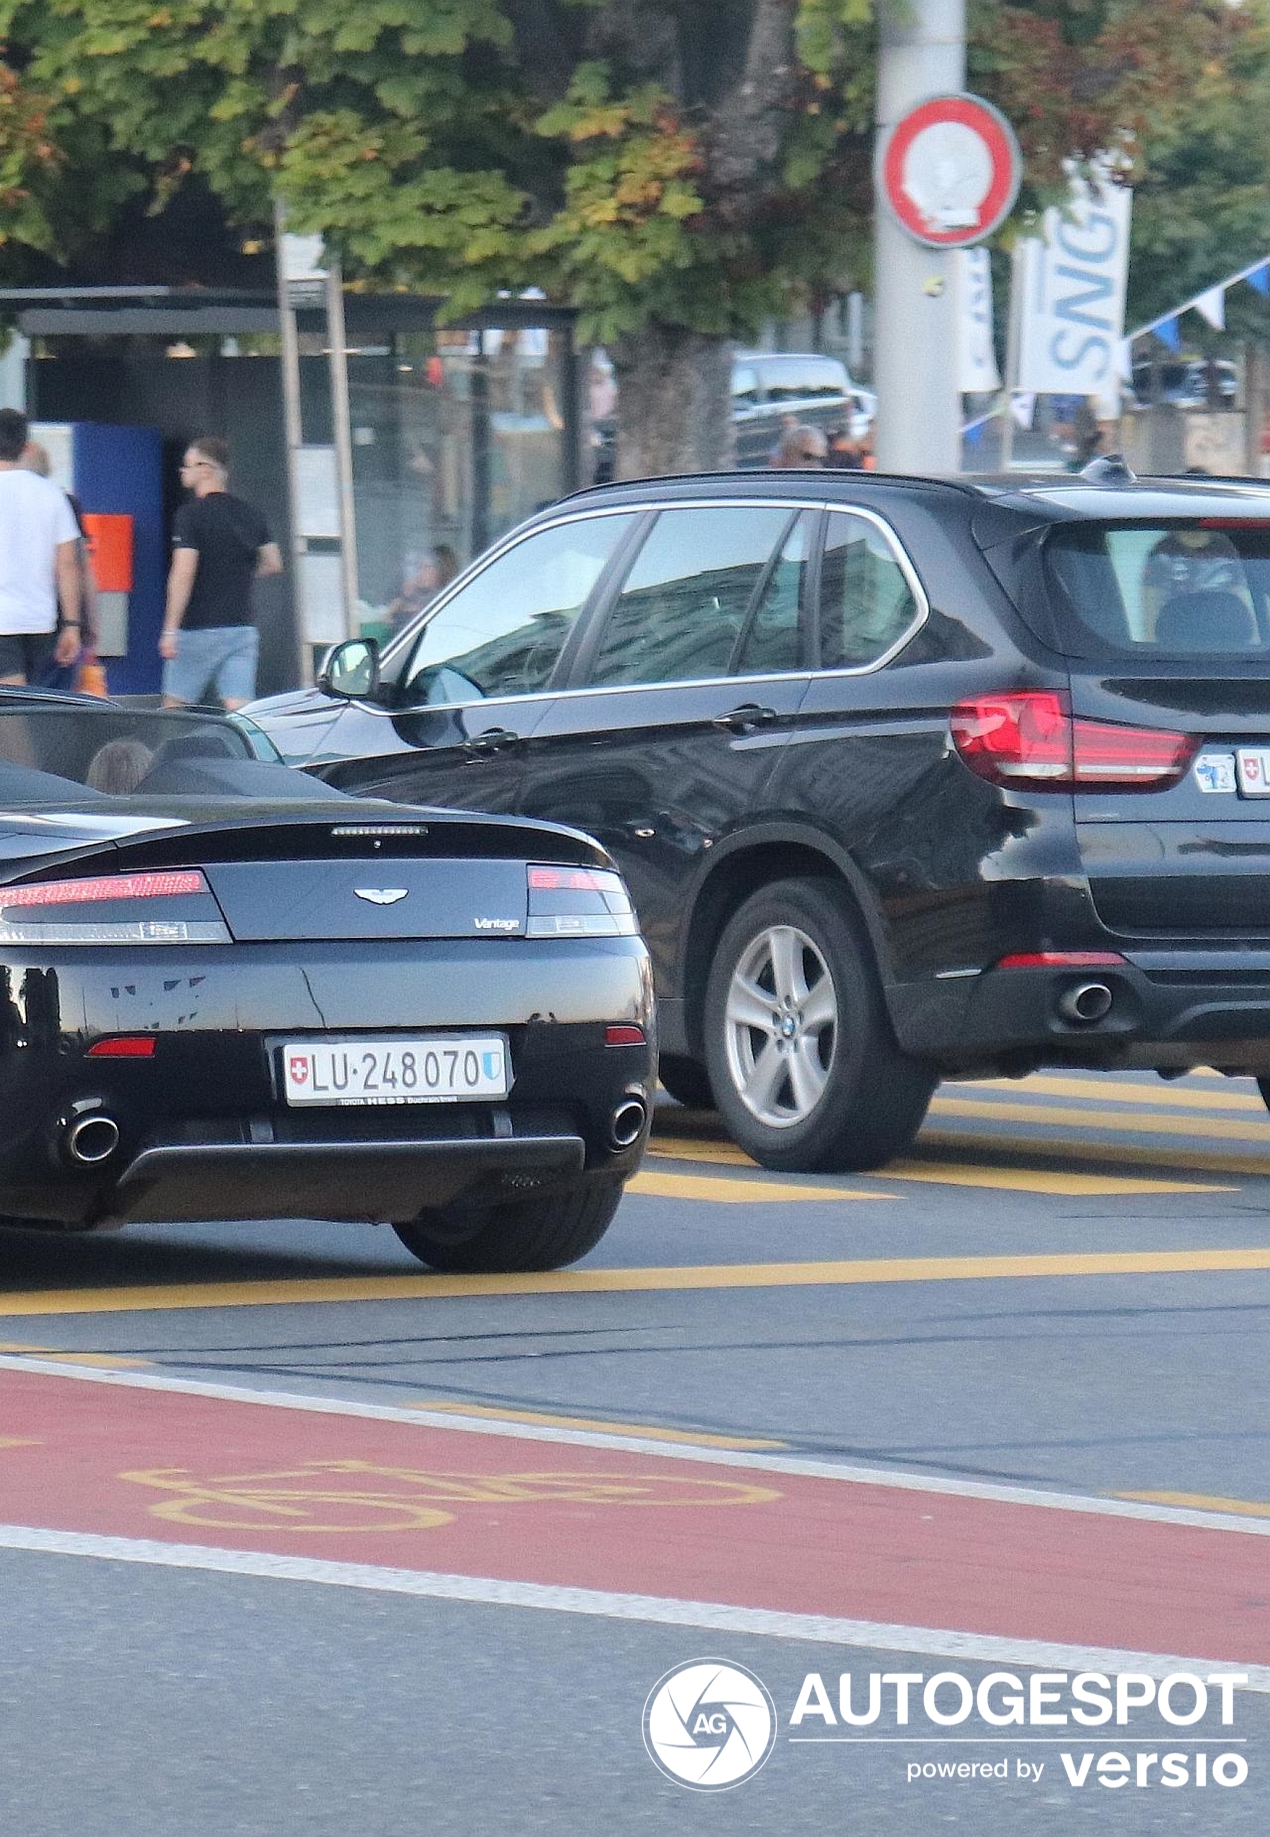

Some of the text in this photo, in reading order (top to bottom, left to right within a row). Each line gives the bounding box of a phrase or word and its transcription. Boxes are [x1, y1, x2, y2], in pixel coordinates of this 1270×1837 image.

[1049, 212, 1116, 381] SNG
[474, 918, 520, 930] Vantage
[367, 1097, 406, 1105] HESS
